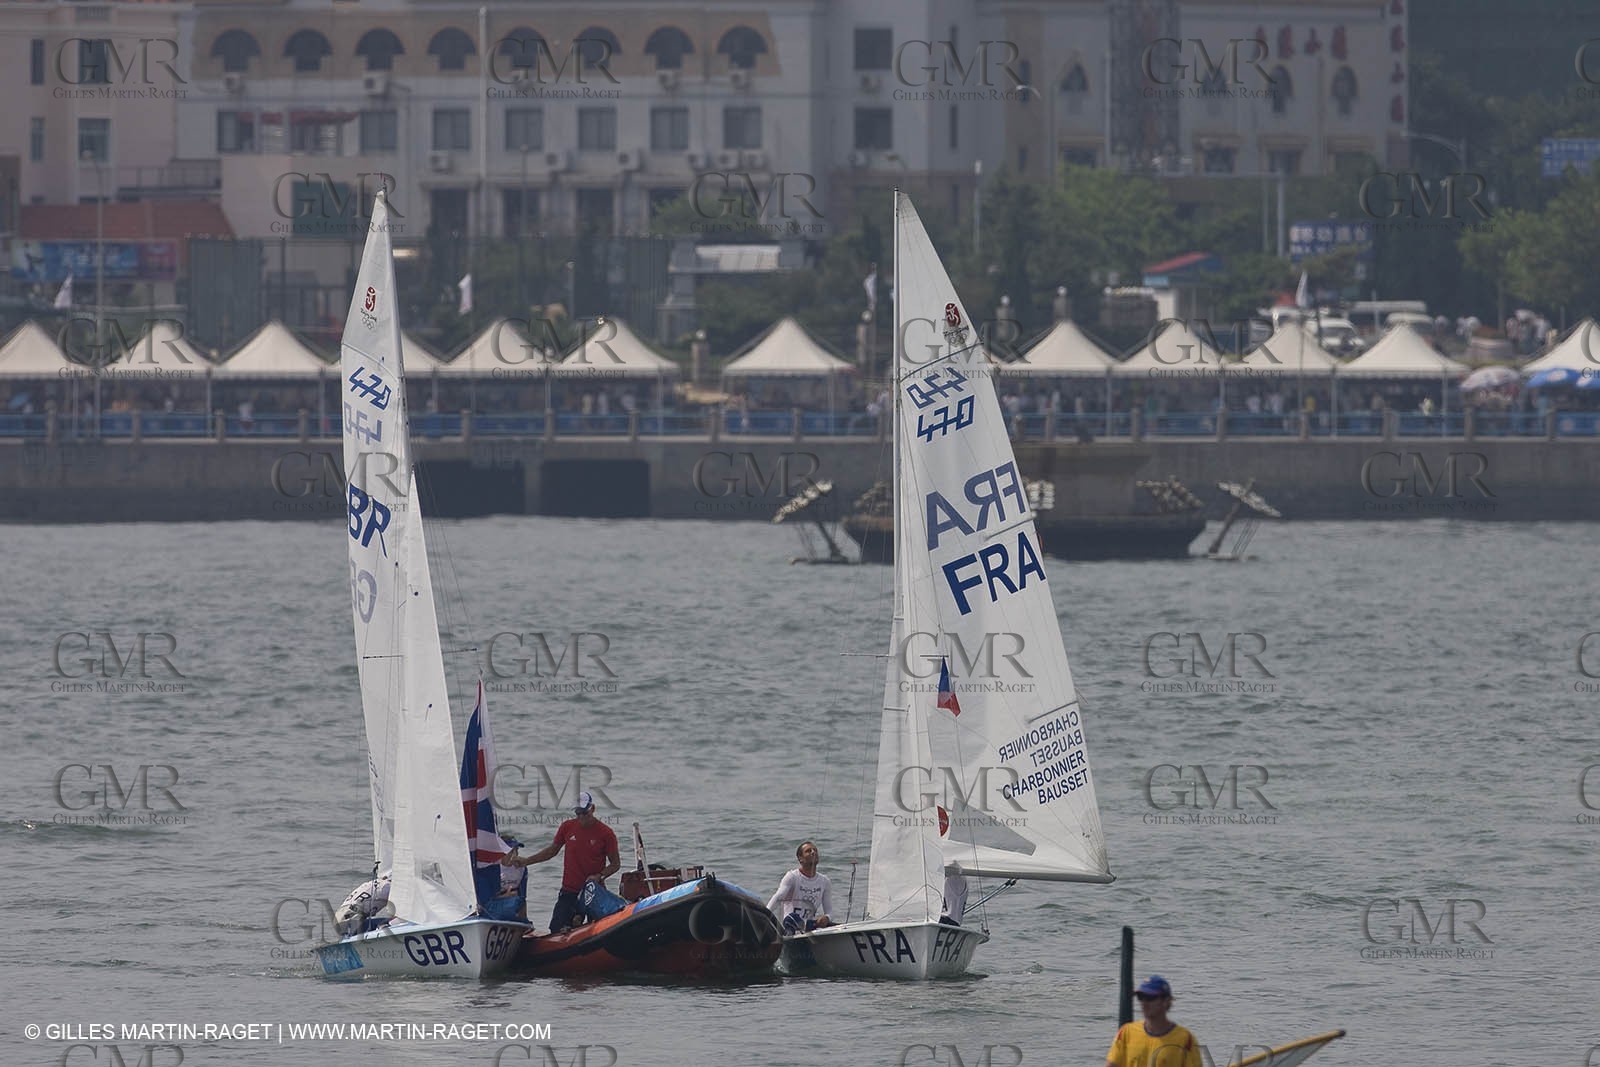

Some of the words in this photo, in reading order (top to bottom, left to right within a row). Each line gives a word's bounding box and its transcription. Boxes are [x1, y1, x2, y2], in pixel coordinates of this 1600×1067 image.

[917, 395, 975, 442] 470
[942, 531, 1046, 615] FRA
[1002, 750, 1086, 800] CHARBONNIER
[1038, 768, 1088, 804] BAUSSET
[404, 930, 471, 966] GBR
[850, 928, 916, 963] FRA
[932, 928, 968, 962] FRA
